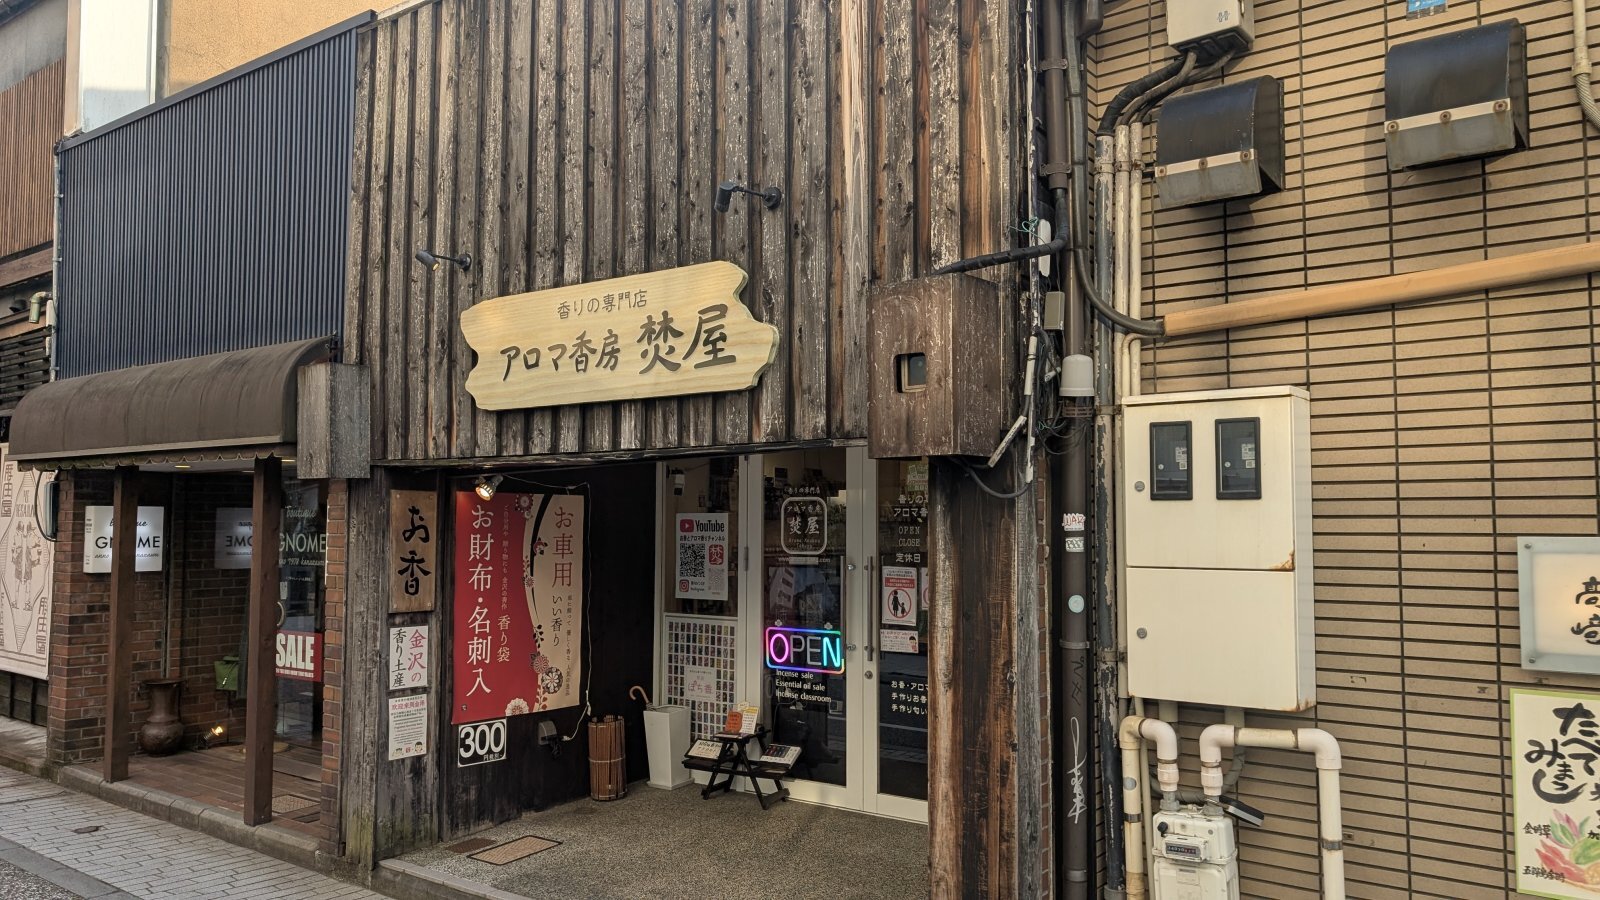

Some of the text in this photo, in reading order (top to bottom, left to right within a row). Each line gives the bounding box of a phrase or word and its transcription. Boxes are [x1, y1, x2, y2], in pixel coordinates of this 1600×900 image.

[556, 289, 648, 320] 香りの専門店
[500, 303, 737, 382] アロマ香房 焚屋
[695, 520, 725, 532] YouTube
[789, 516, 820, 535] 焚屋
[898, 526, 920, 535] OPEN
[95, 536, 161, 549] GME
[397, 505, 431, 596] お香
[898, 538, 920, 547] CLOSE
[895, 553, 921, 563] 定休日
[550, 506, 575, 647] お車用 いい香り
[466, 504, 494, 697] お財布・名刺入
[275, 633, 315, 671] SALE
[496, 615, 511, 664] 香り袋
[770, 633, 841, 668] OPEN
[391, 628, 407, 688] 香り土産
[407, 629, 427, 682] 金沢の
[775, 679, 826, 692] Essential oil sale
[776, 668, 814, 680] Incense sale
[776, 689, 832, 703] Incense classroom
[891, 692, 928, 704] 手作りお香
[460, 722, 505, 758] 300
[1523, 821, 1551, 838] 金時草
